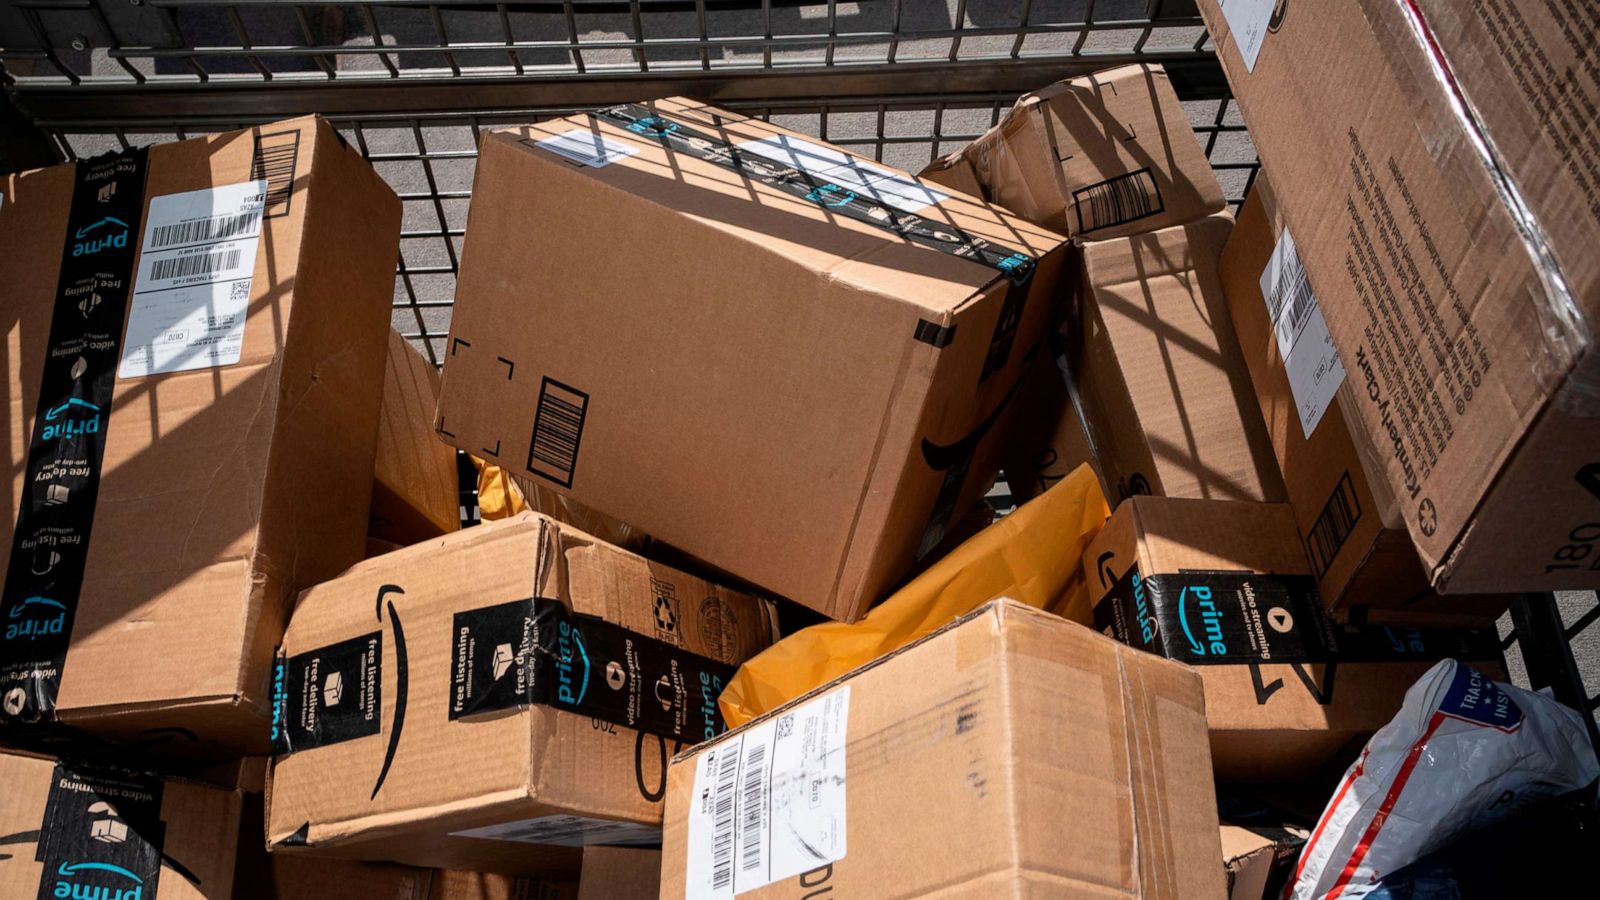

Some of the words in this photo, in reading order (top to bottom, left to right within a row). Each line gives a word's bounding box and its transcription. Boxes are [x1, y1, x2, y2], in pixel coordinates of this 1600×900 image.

[1361, 261, 1382, 305] imported
[1396, 264, 1427, 329] Kimberly-Clark
[1414, 279, 1426, 296] de
[1363, 324, 1375, 343] por
[1420, 321, 1431, 336] of
[1402, 353, 1416, 382] from
[1427, 332, 1453, 388] Trademarks
[1392, 367, 1409, 401] Global
[1411, 375, 1424, 401] USA
[1356, 345, 1421, 500] Kimberly-Clark
[1420, 393, 1431, 416] the
[1427, 410, 1435, 428] in
[1431, 390, 1454, 441] Fabricado
[1396, 403, 1421, 458] Distributed
[1406, 395, 1438, 468] Kimberly-Clark
[1431, 421, 1447, 454] Made
[69, 466, 89, 477] free
[60, 533, 81, 544] free
[1544, 522, 1600, 573] 180
[1130, 571, 1152, 644] prime
[1188, 585, 1227, 656] prime
[1235, 589, 1246, 611] movies
[1242, 611, 1251, 623] and
[1247, 631, 1257, 650] shows
[1242, 581, 1256, 608] video
[1250, 608, 1271, 659] streaming
[367, 638, 377, 664] free
[455, 626, 469, 683] listening
[514, 616, 531, 665] dlivery
[310, 657, 320, 682] free
[515, 667, 525, 694] free
[554, 619, 575, 704] prime
[624, 638, 636, 692] streaming
[305, 684, 318, 731] delivery
[364, 666, 376, 720] listening
[454, 685, 464, 712] free
[626, 694, 635, 726] video
[673, 710, 681, 734] free
[58, 777, 119, 797] streaming
